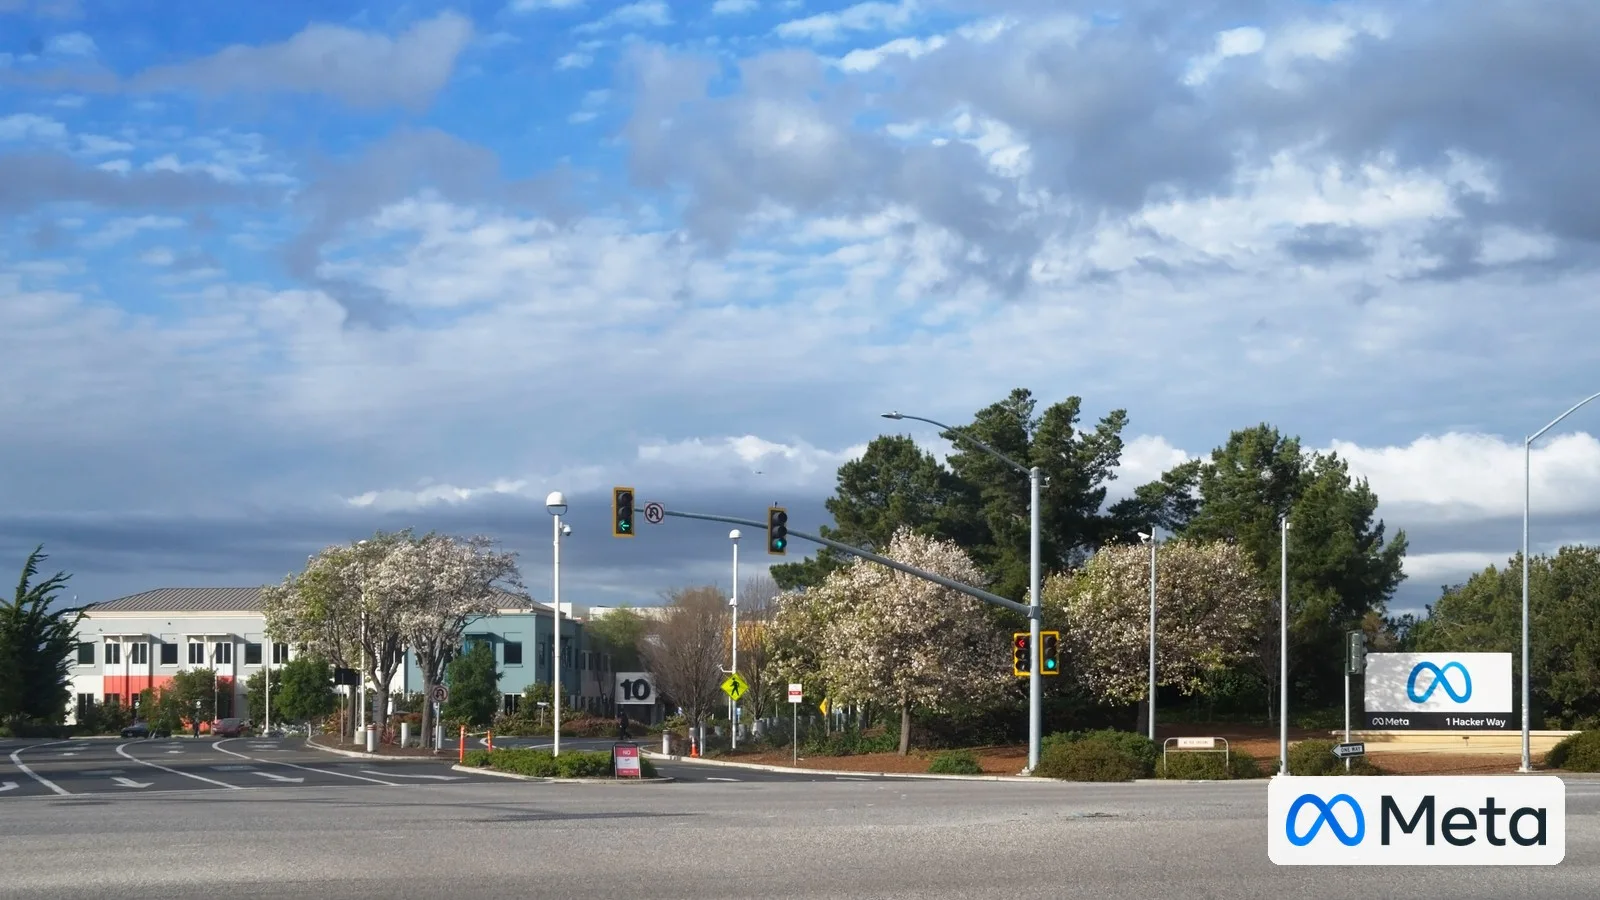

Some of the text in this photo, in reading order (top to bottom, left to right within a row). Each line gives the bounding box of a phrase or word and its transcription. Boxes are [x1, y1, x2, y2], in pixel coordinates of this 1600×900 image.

[620, 679, 651, 700] 10
[1385, 717, 1410, 726] Meta
[1446, 717, 1506, 728] 1 Hacker Way
